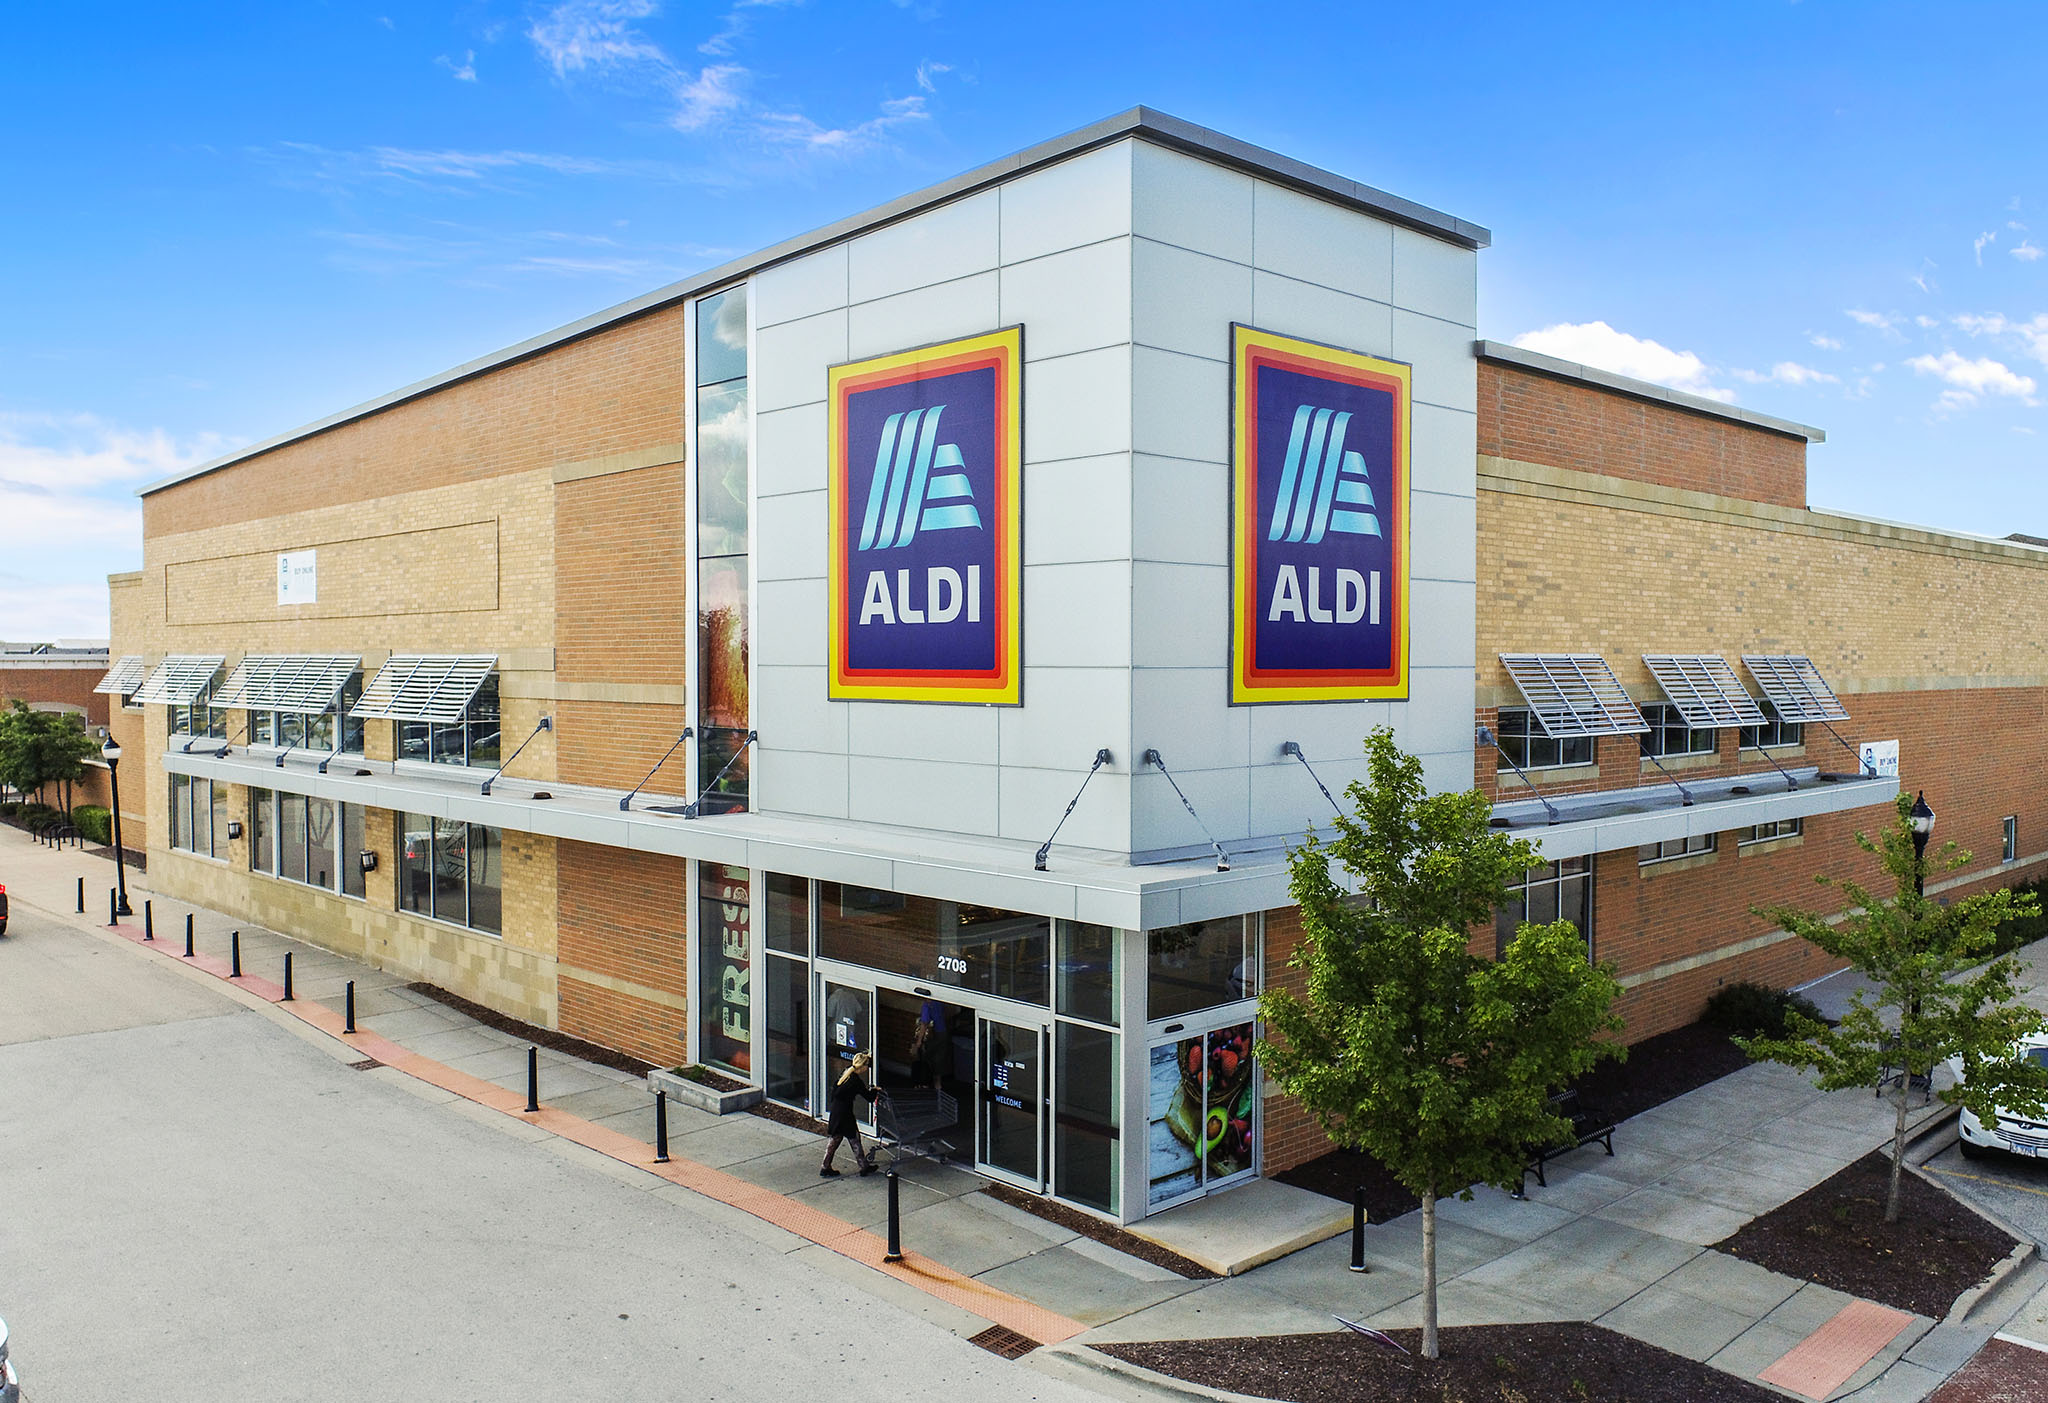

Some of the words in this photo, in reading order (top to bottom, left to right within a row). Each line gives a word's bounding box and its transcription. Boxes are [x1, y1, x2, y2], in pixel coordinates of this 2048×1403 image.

[859, 564, 981, 625] ALDI
[1268, 564, 1381, 625] ALDI
[937, 955, 967, 974] 2708
[995, 1094, 1022, 1109] WELCOME
